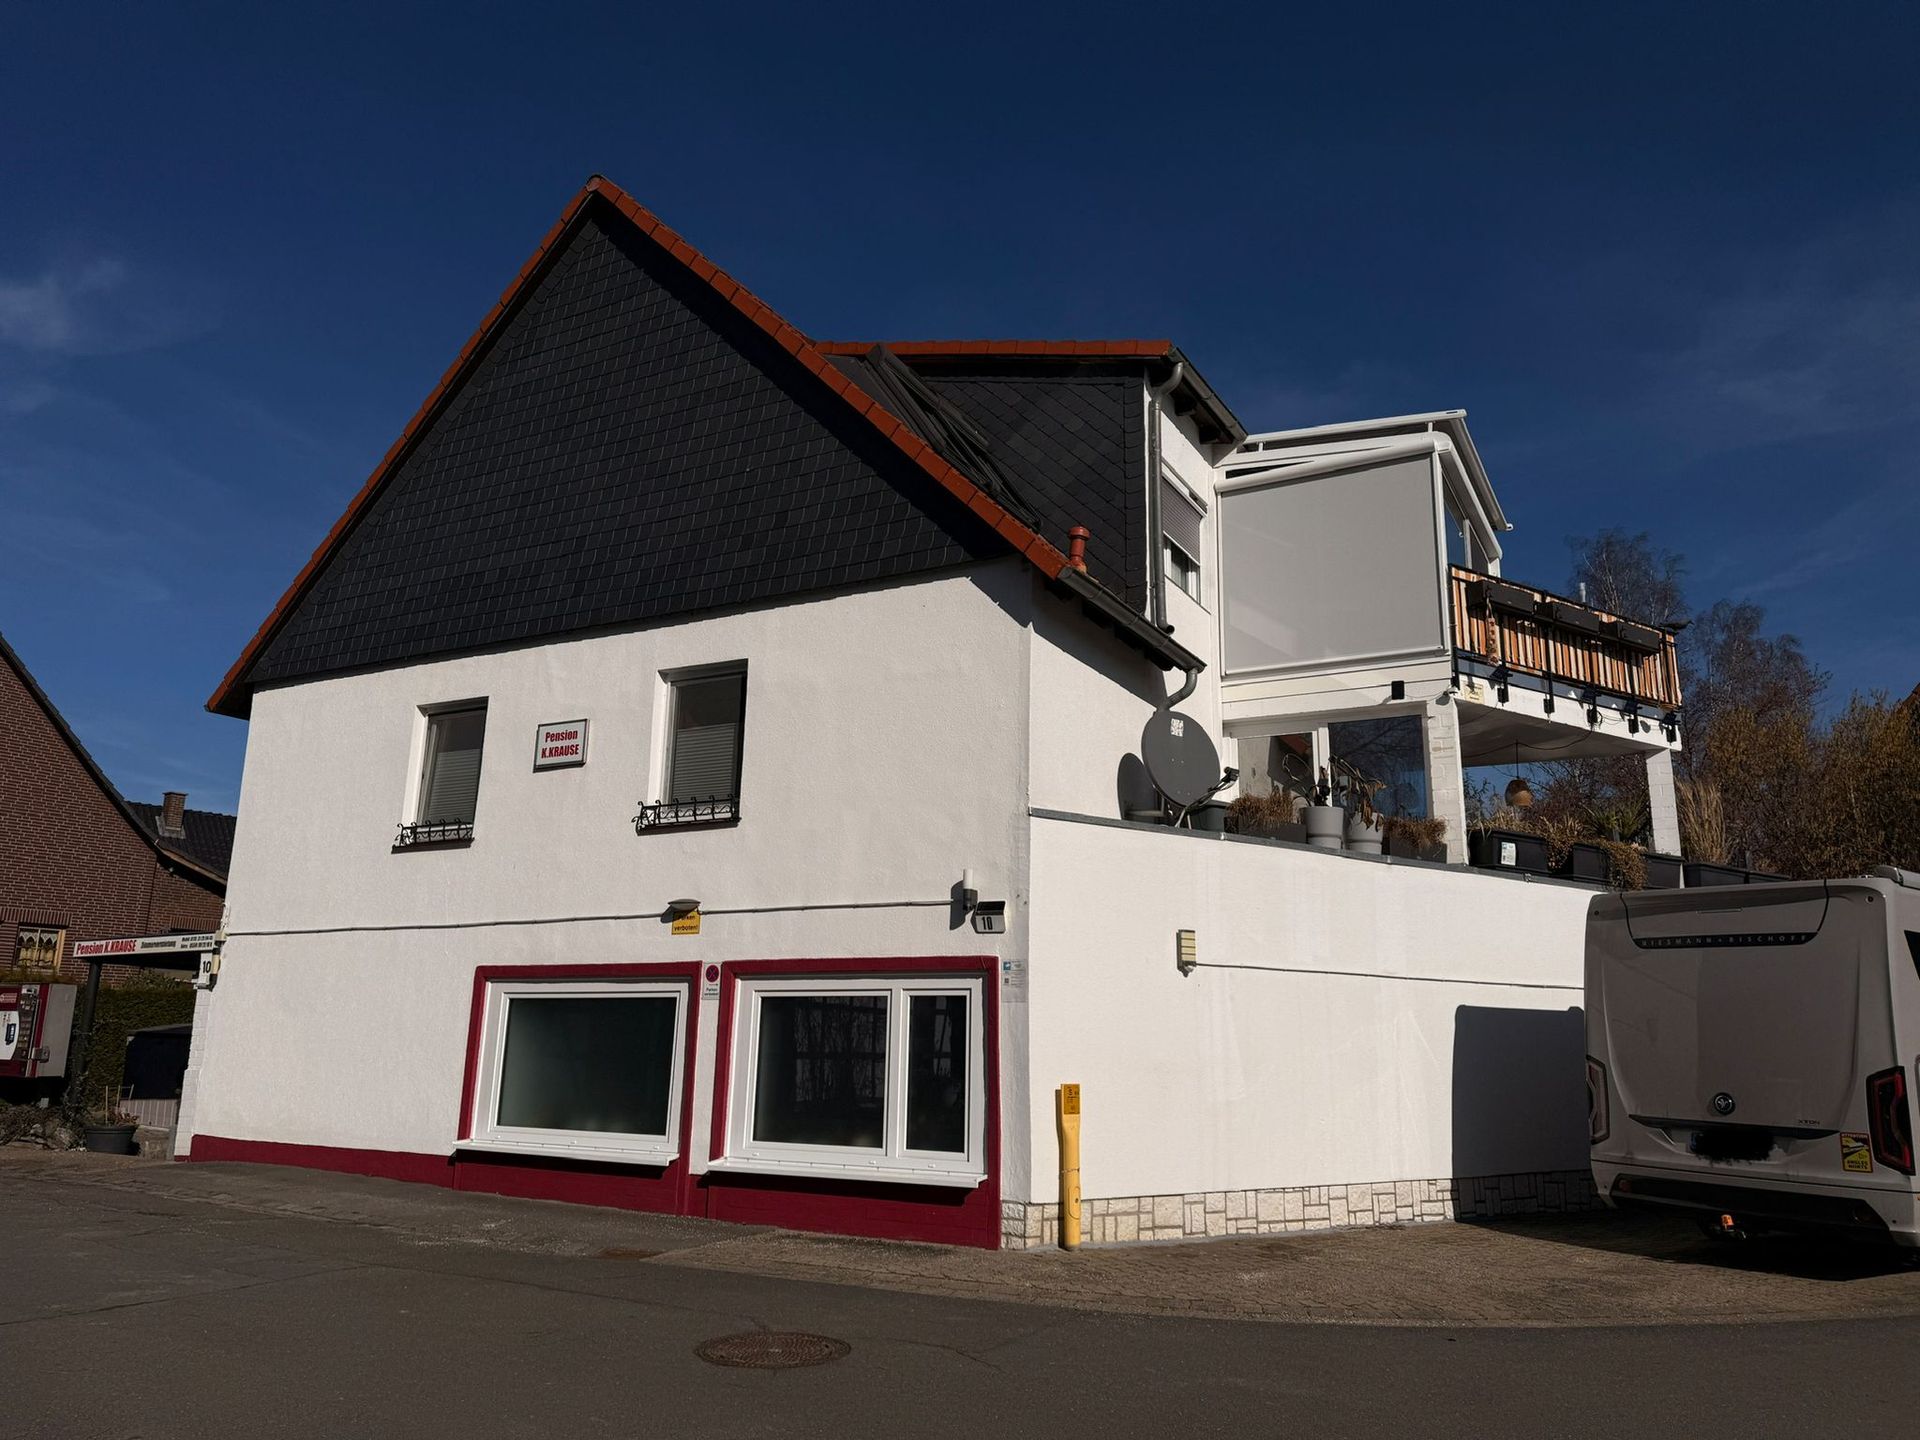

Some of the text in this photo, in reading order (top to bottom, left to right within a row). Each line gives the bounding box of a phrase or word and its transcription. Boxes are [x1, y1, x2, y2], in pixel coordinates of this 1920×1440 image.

[545, 729, 578, 743] Pension
[541, 744, 580, 759] K.KRAUSE
[981, 916, 993, 930] 10
[76, 942, 104, 955] Pension
[202, 960, 212, 974] 10
